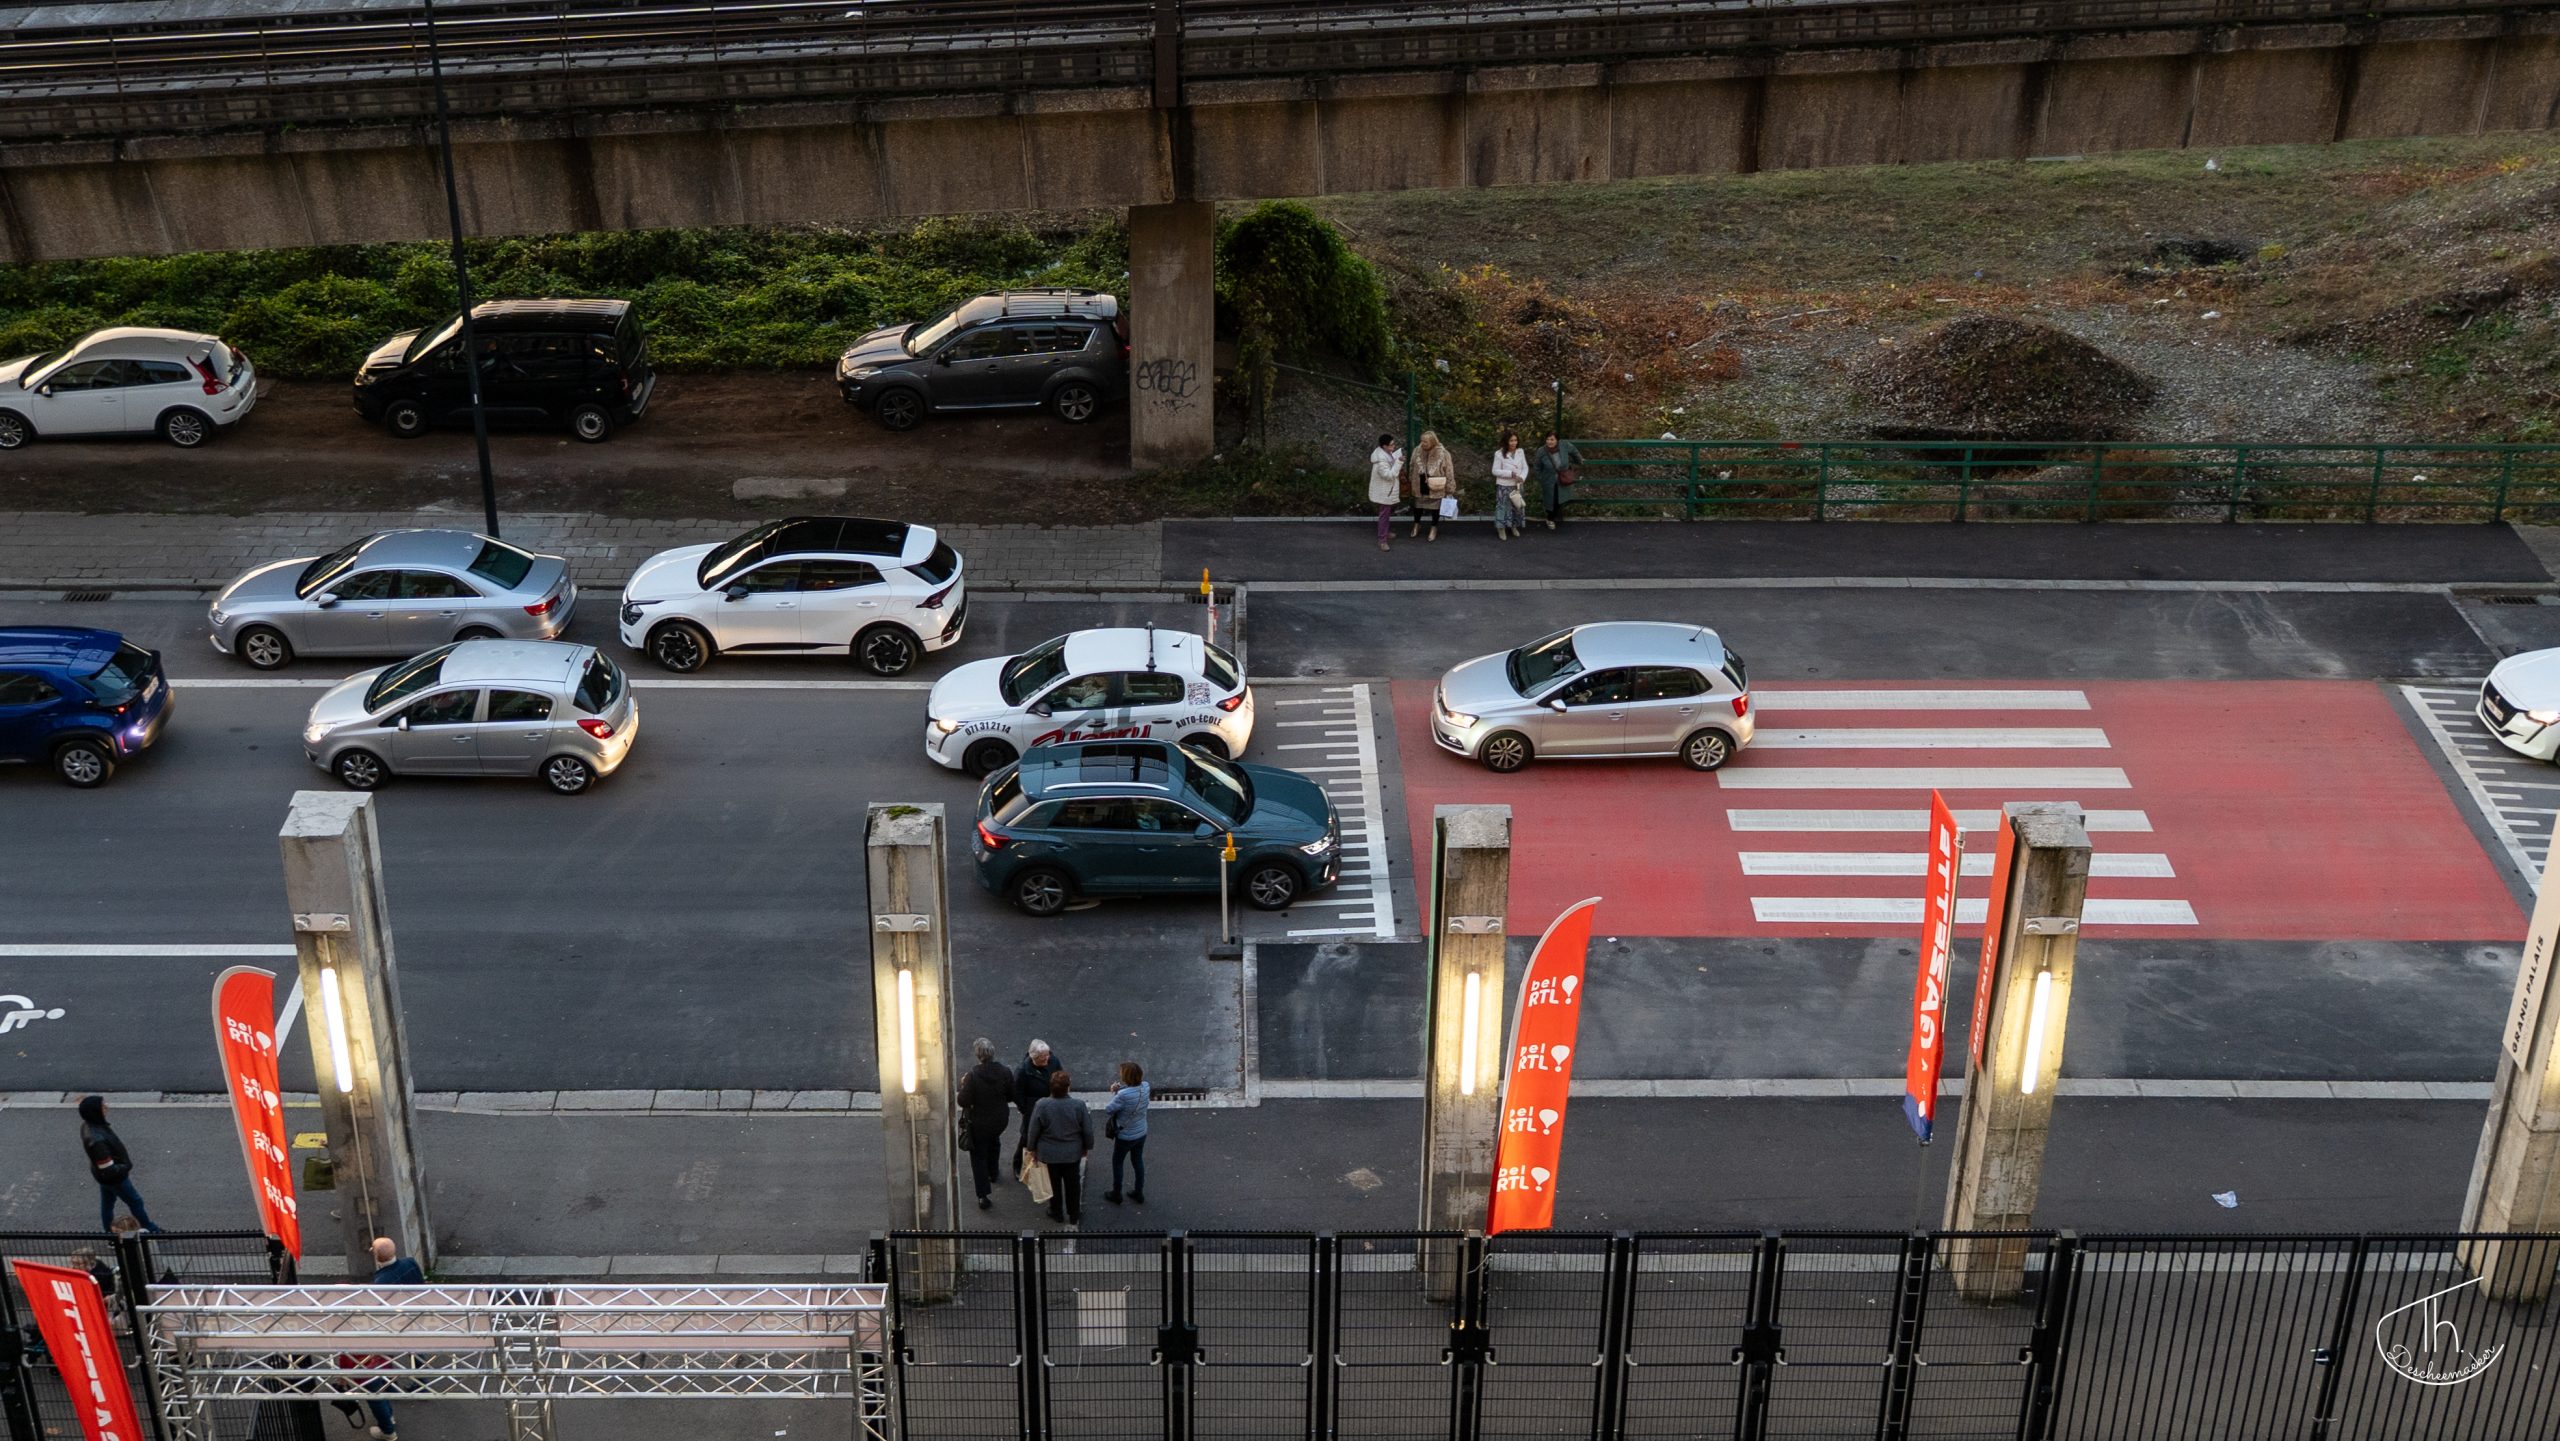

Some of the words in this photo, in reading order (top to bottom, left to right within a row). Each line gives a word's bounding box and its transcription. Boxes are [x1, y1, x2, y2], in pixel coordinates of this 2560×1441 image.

[965, 723, 979, 736] 071
[979, 721, 989, 730] 31
[991, 721, 1001, 730] 21
[1002, 724, 1012, 734] 14
[1175, 714, 1222, 729] AUTO-ÉCOLE
[1531, 976, 1557, 991] bel
[1528, 989, 1559, 1008] RTL
[1972, 998, 1984, 1055] GRAND
[1980, 935, 1993, 995] PALAIS
[2511, 998, 2528, 1054] GRAND
[2525, 935, 2544, 995] PALAIS
[229, 1027, 259, 1052] RTL
[1517, 1054, 1548, 1073] RTL
[1496, 1175, 1529, 1193] RTL
